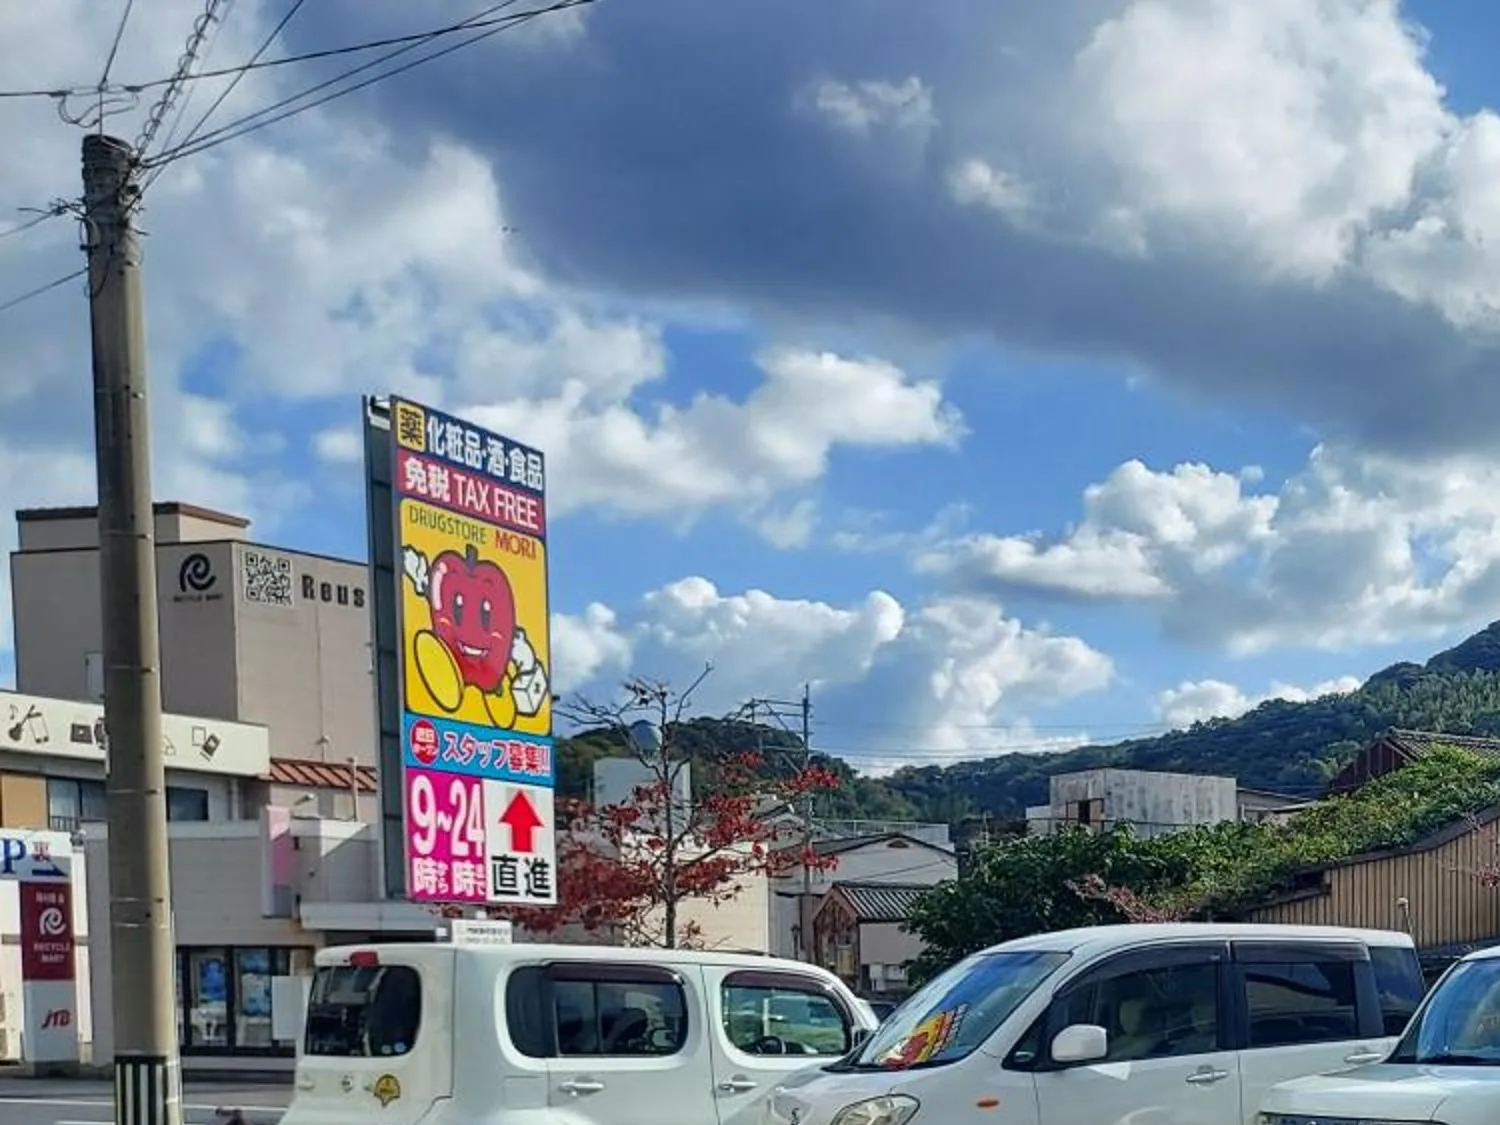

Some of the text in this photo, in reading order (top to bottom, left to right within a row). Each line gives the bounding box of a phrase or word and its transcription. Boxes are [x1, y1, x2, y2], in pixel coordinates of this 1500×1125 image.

[404, 457, 539, 531] 免税 TAX FREE
[409, 504, 537, 561] DRUGSTORE MORI
[302, 574, 365, 608] Reus
[0, 838, 27, 875] P
[491, 854, 552, 898] 直進
